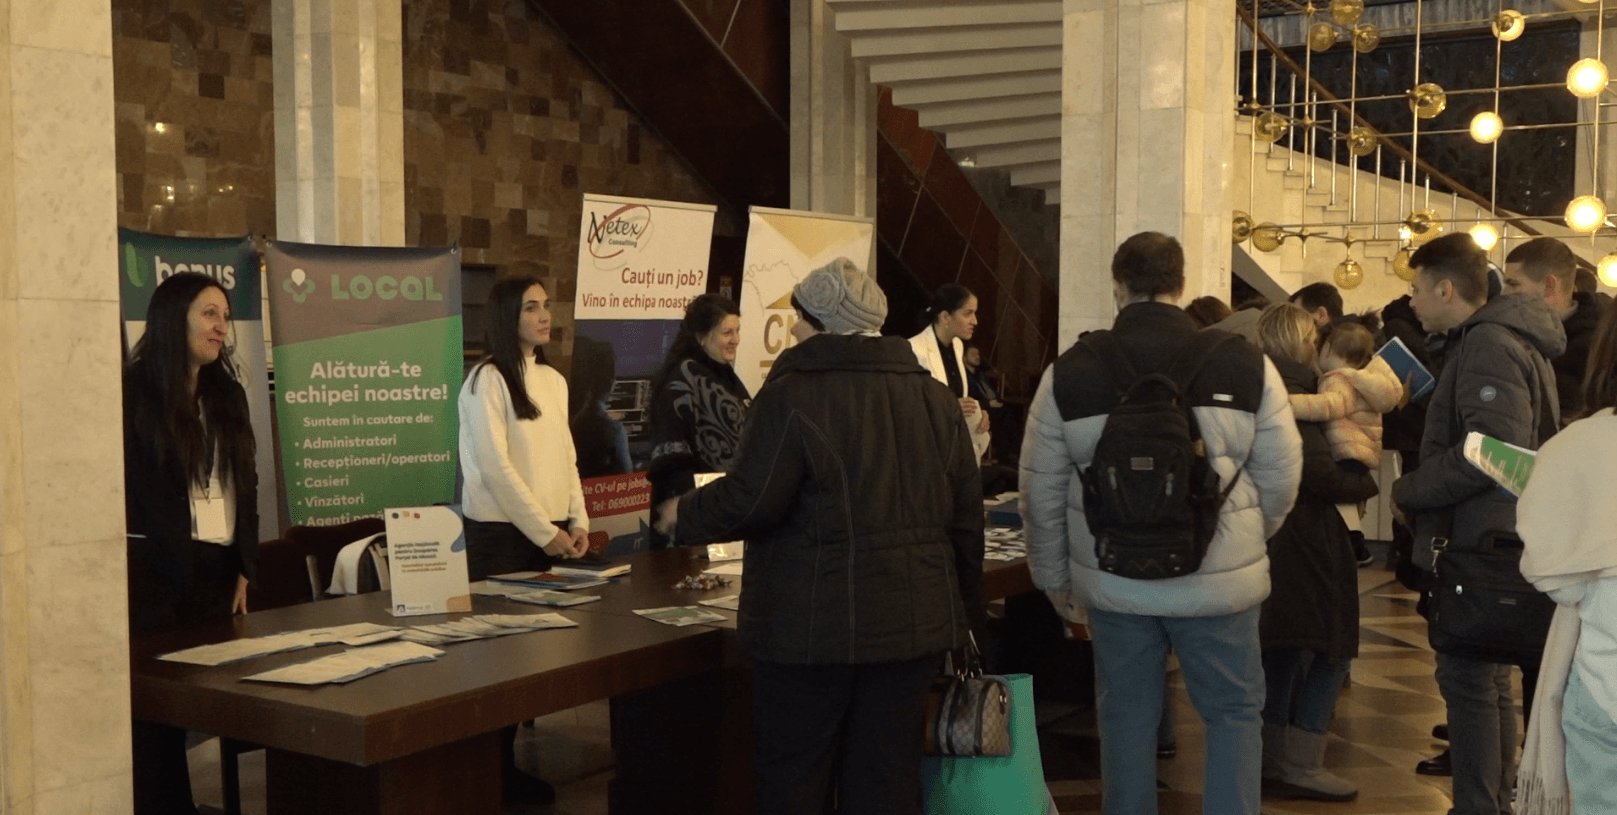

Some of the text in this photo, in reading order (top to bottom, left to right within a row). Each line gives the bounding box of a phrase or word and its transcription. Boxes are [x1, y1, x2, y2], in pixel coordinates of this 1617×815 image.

[621, 267, 704, 289] Cauți un job?
[582, 293, 697, 311] Vino în echipa noast
[310, 361, 422, 379] Alătură-te
[285, 384, 448, 406] echipei noastre!
[303, 412, 434, 427] Suntem în cautare de:
[303, 434, 397, 449] Administratori
[304, 474, 349, 488] Casieri
[617, 481, 627, 493] pe
